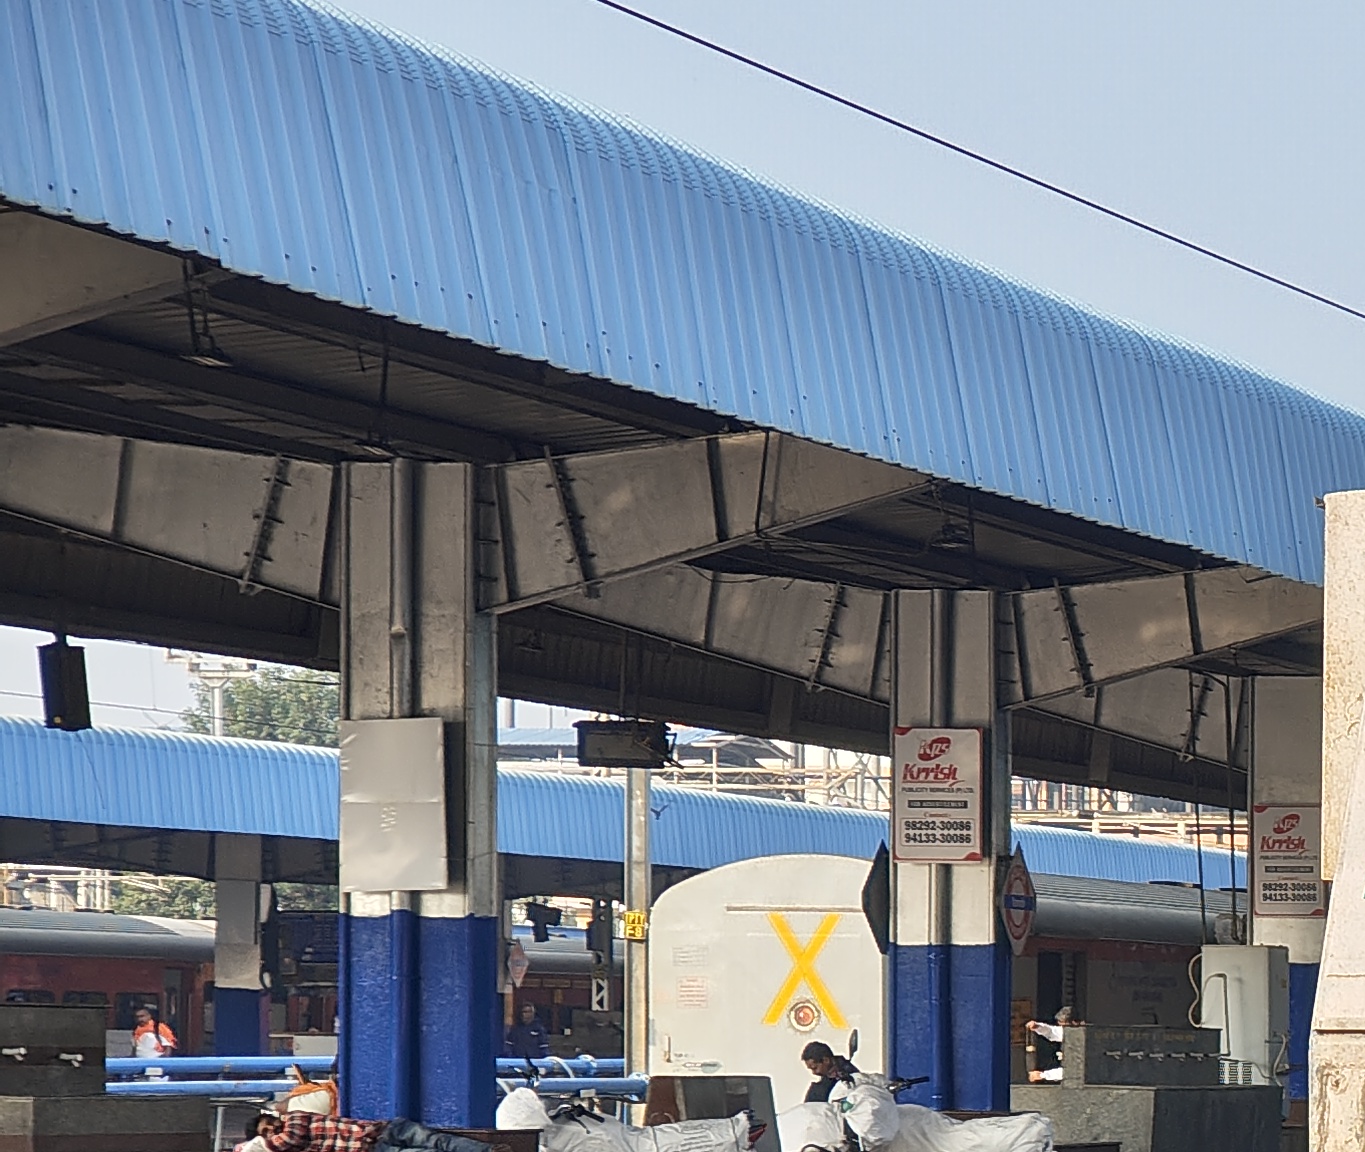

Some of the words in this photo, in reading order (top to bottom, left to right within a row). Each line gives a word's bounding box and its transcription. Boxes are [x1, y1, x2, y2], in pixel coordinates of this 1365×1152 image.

[904, 820, 972, 831] 98292-30086
[904, 832, 972, 844] 94133-30086
[762, 912, 849, 1029] X
